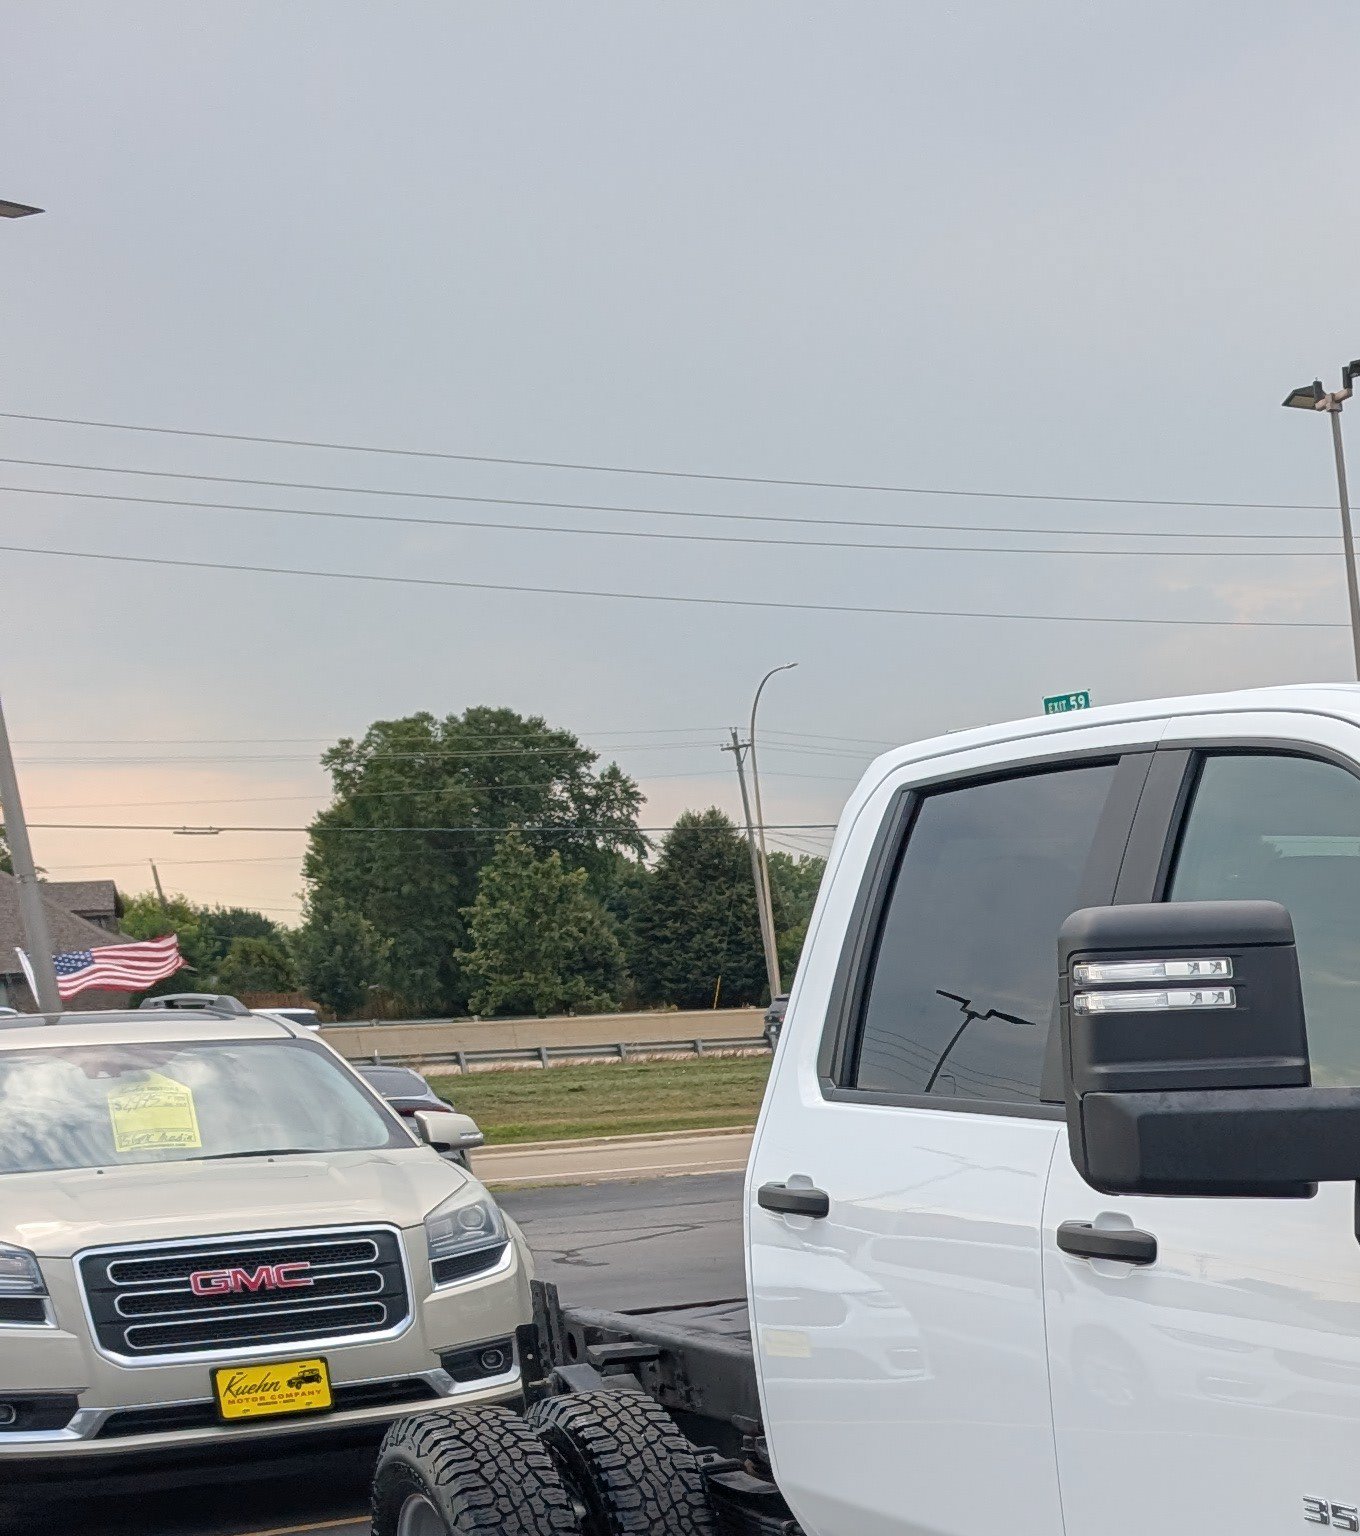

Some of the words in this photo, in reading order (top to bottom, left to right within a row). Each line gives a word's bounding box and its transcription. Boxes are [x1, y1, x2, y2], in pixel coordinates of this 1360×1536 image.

[1069, 695, 1086, 710] 59
[189, 1261, 315, 1296] GMC
[223, 1371, 282, 1398] Kuehn
[227, 1395, 266, 1406] MOTOR
[270, 1389, 322, 1400] COMPANY
